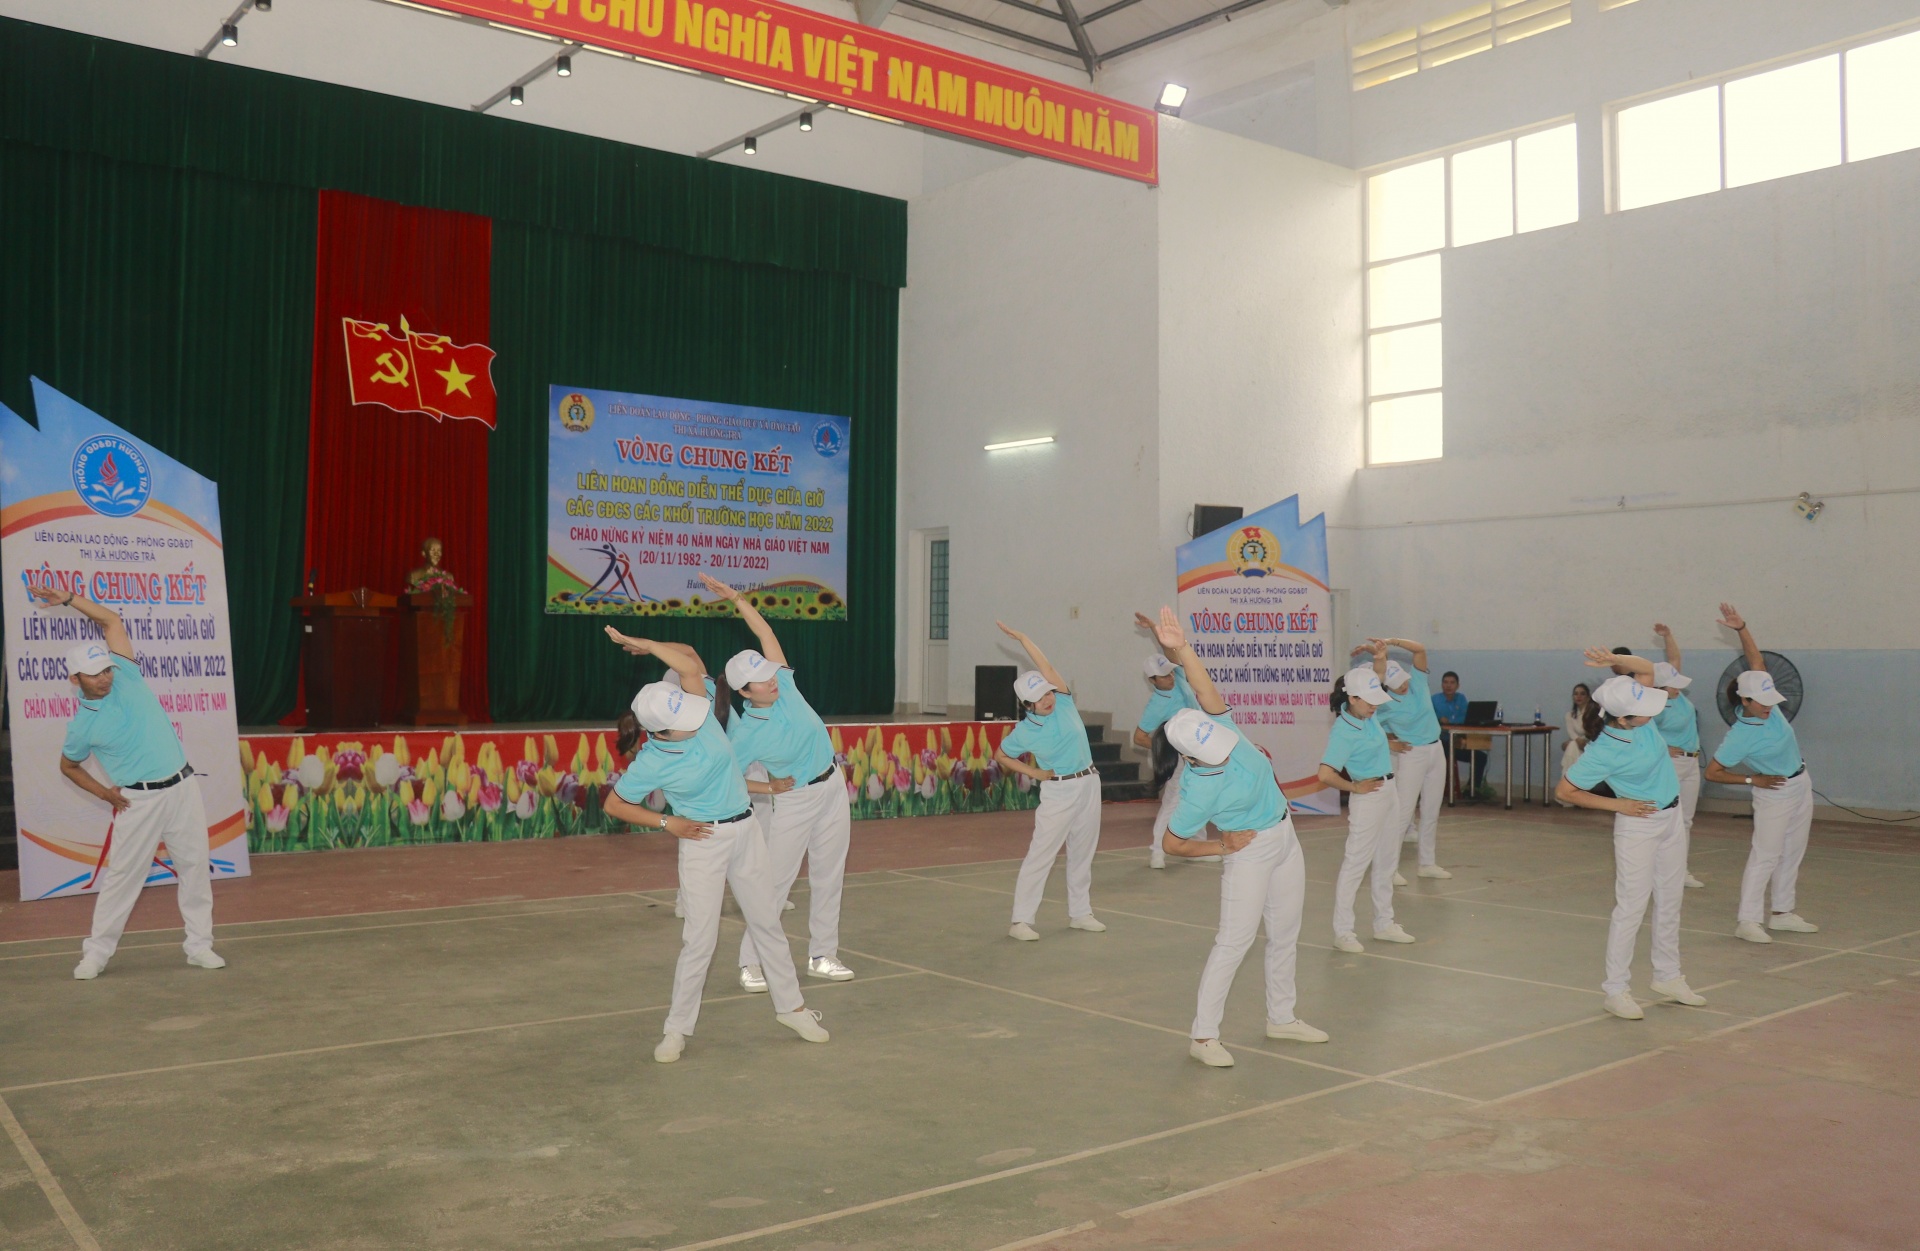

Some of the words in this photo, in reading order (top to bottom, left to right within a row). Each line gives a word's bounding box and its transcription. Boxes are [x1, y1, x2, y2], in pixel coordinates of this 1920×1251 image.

[674, 0, 794, 72] NGHĨA
[802, 34, 878, 95] VIỆT
[887, 56, 967, 117] NAM
[974, 81, 1065, 144] MUÔN
[1071, 106, 1139, 162] NĂM
[608, 403, 628, 415] LIÊN
[652, 408, 668, 419] LAO
[75, 453, 89, 490] PHÒNG
[86, 439, 117, 454] GD&ĐT
[616, 435, 674, 464] VÒNG
[680, 445, 748, 470] CHUNG
[753, 444, 793, 473] KẾT
[577, 469, 608, 491] LIÊN
[611, 474, 647, 494] HOAN
[688, 475, 717, 499] DIỄN
[720, 477, 745, 501] THỂ
[748, 486, 772, 506] DỤC
[775, 486, 802, 506] GIỮA
[804, 487, 826, 507] GIỜ
[566, 495, 594, 517] CÁC
[596, 500, 631, 520] CĐCS
[633, 499, 660, 521] CÁC
[663, 501, 694, 523] KHỐI
[697, 505, 746, 527] TRƯỜNG
[748, 511, 773, 531] HỌC
[776, 510, 802, 530] NĂM
[804, 515, 834, 532] 2022
[34, 530, 55, 542] LIÊN
[56, 530, 82, 544] ĐOÀN
[85, 534, 101, 544] LAO
[103, 533, 129, 547] ĐỘNG
[136, 535, 165, 548] PHÒNG
[167, 538, 194, 548] GD&ĐT
[80, 549, 92, 561] THỊ
[95, 547, 107, 560] XÃ
[109, 549, 140, 561] HƯƠNG
[142, 549, 156, 561] TRÀ
[570, 524, 598, 542] CHÀO
[601, 525, 629, 543] NỪNG
[631, 526, 645, 544] KỶ
[648, 529, 673, 548] NIỆM
[676, 533, 688, 547] 40
[692, 532, 713, 549] NĂM
[716, 533, 740, 549] NGÀY
[743, 535, 761, 551] NHÀ
[764, 536, 785, 552] GIÁO
[788, 537, 807, 555] VIỆT
[810, 541, 830, 554] NAM
[639, 550, 701, 567] (20/11/1982
[710, 553, 769, 571] 20/11/2022)
[25, 560, 86, 600] VÒNG
[93, 570, 162, 601] CHUNG
[167, 560, 207, 602] KẾT
[1230, 587, 1241, 595] LAO
[23, 611, 47, 641] LIÊN
[50, 617, 78, 641] HOAN
[134, 606, 153, 640] THỂ
[156, 618, 176, 645] DỤC
[177, 613, 199, 640] GIỮA
[200, 612, 215, 640] GIỜ
[1192, 607, 1231, 631] VÒNG
[1236, 612, 1285, 631] CHUNG
[1289, 603, 1318, 631] KẾT
[1207, 643, 1225, 658] HOAN
[1246, 636, 1262, 658] DIỄN
[1264, 635, 1277, 657] THỂ
[1279, 643, 1293, 661] DỤC
[1294, 639, 1311, 657] GIỮA
[1312, 639, 1323, 658] GIỜ
[18, 651, 39, 681] CÁC
[42, 656, 69, 681] CĐCS
[160, 655, 180, 682] HỌC
[181, 651, 202, 677] NĂM
[204, 655, 226, 676] 2022
[1220, 664, 1233, 683] CÁC
[1234, 662, 1251, 683] KHỐI
[1253, 664, 1280, 683] TRƯỜNG
[1281, 667, 1295, 685] HỌC
[1296, 664, 1312, 683] NĂM
[1313, 668, 1330, 682] 2022
[24, 692, 46, 719] CHÀO
[175, 688, 192, 713] GIÁO
[194, 687, 209, 715] VIỆT
[211, 692, 227, 711] NAM
[1317, 693, 1330, 706] NAM
